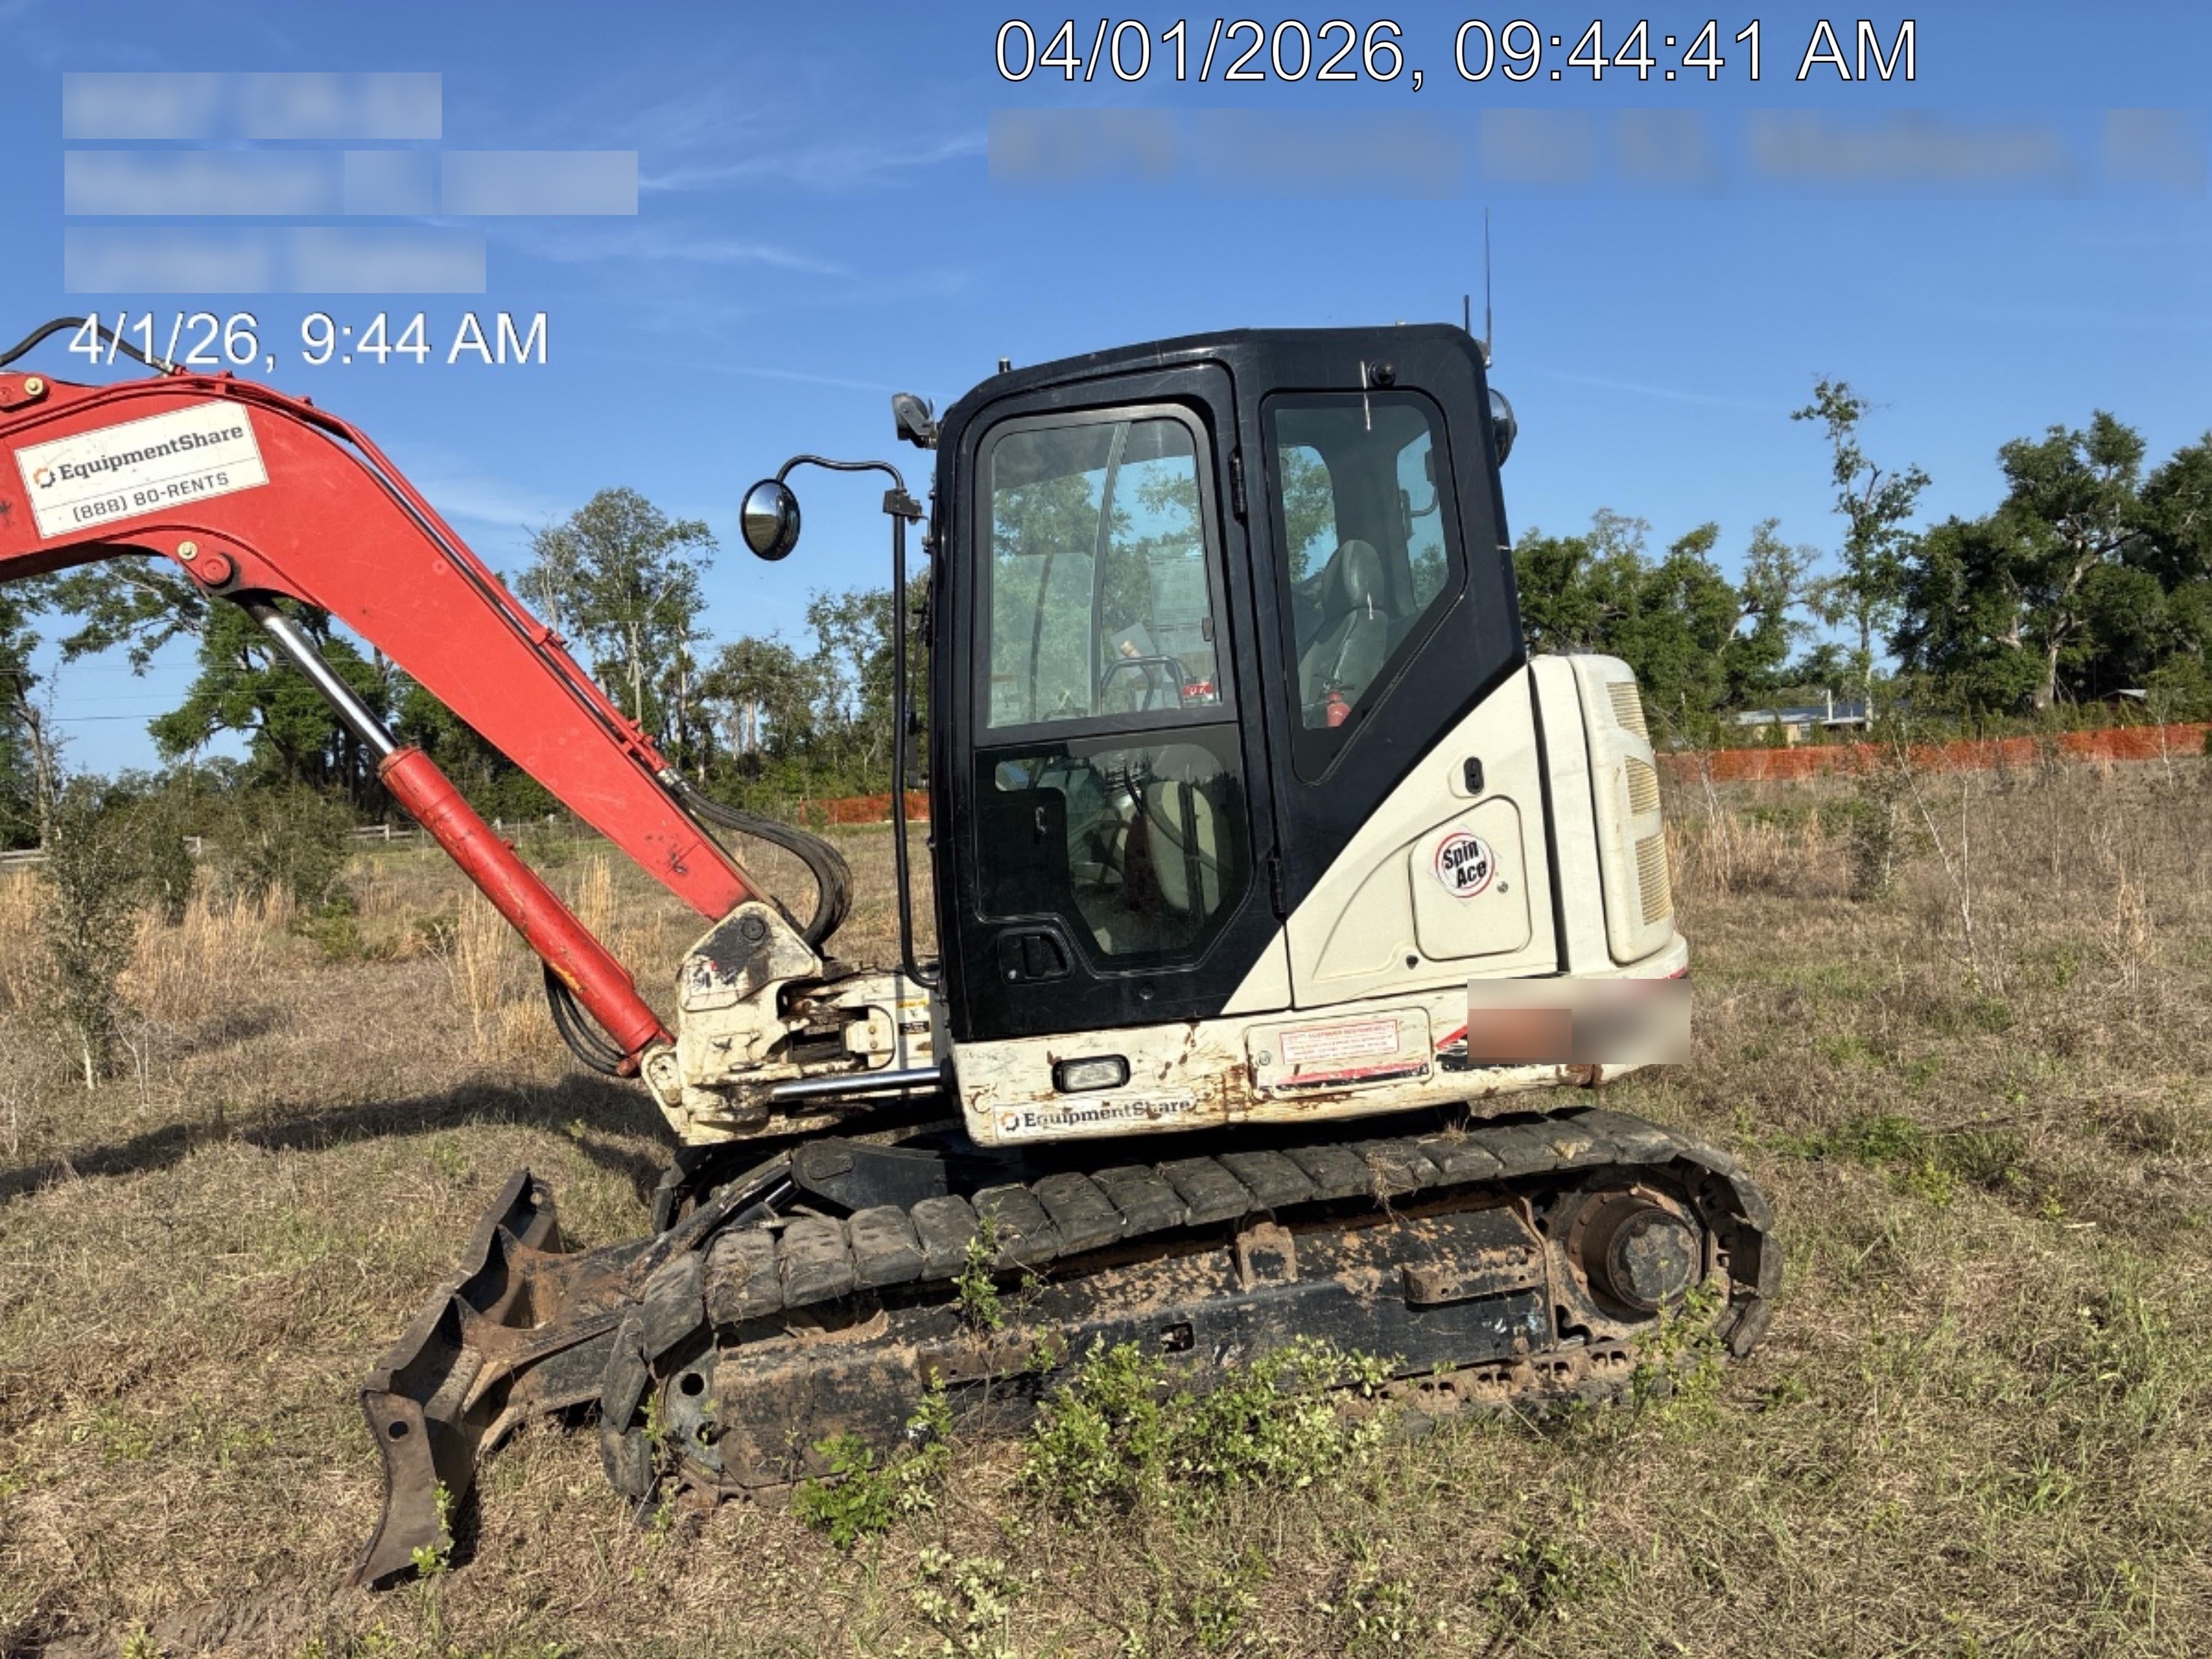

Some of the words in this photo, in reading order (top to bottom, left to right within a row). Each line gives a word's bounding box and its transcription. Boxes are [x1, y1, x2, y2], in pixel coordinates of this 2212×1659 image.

[58, 425, 244, 480] EquipmentShare
[73, 495, 128, 522] (888)
[133, 472, 230, 506] 80-RENTS
[1443, 840, 1479, 871] Spin
[1456, 860, 1487, 888] Ace
